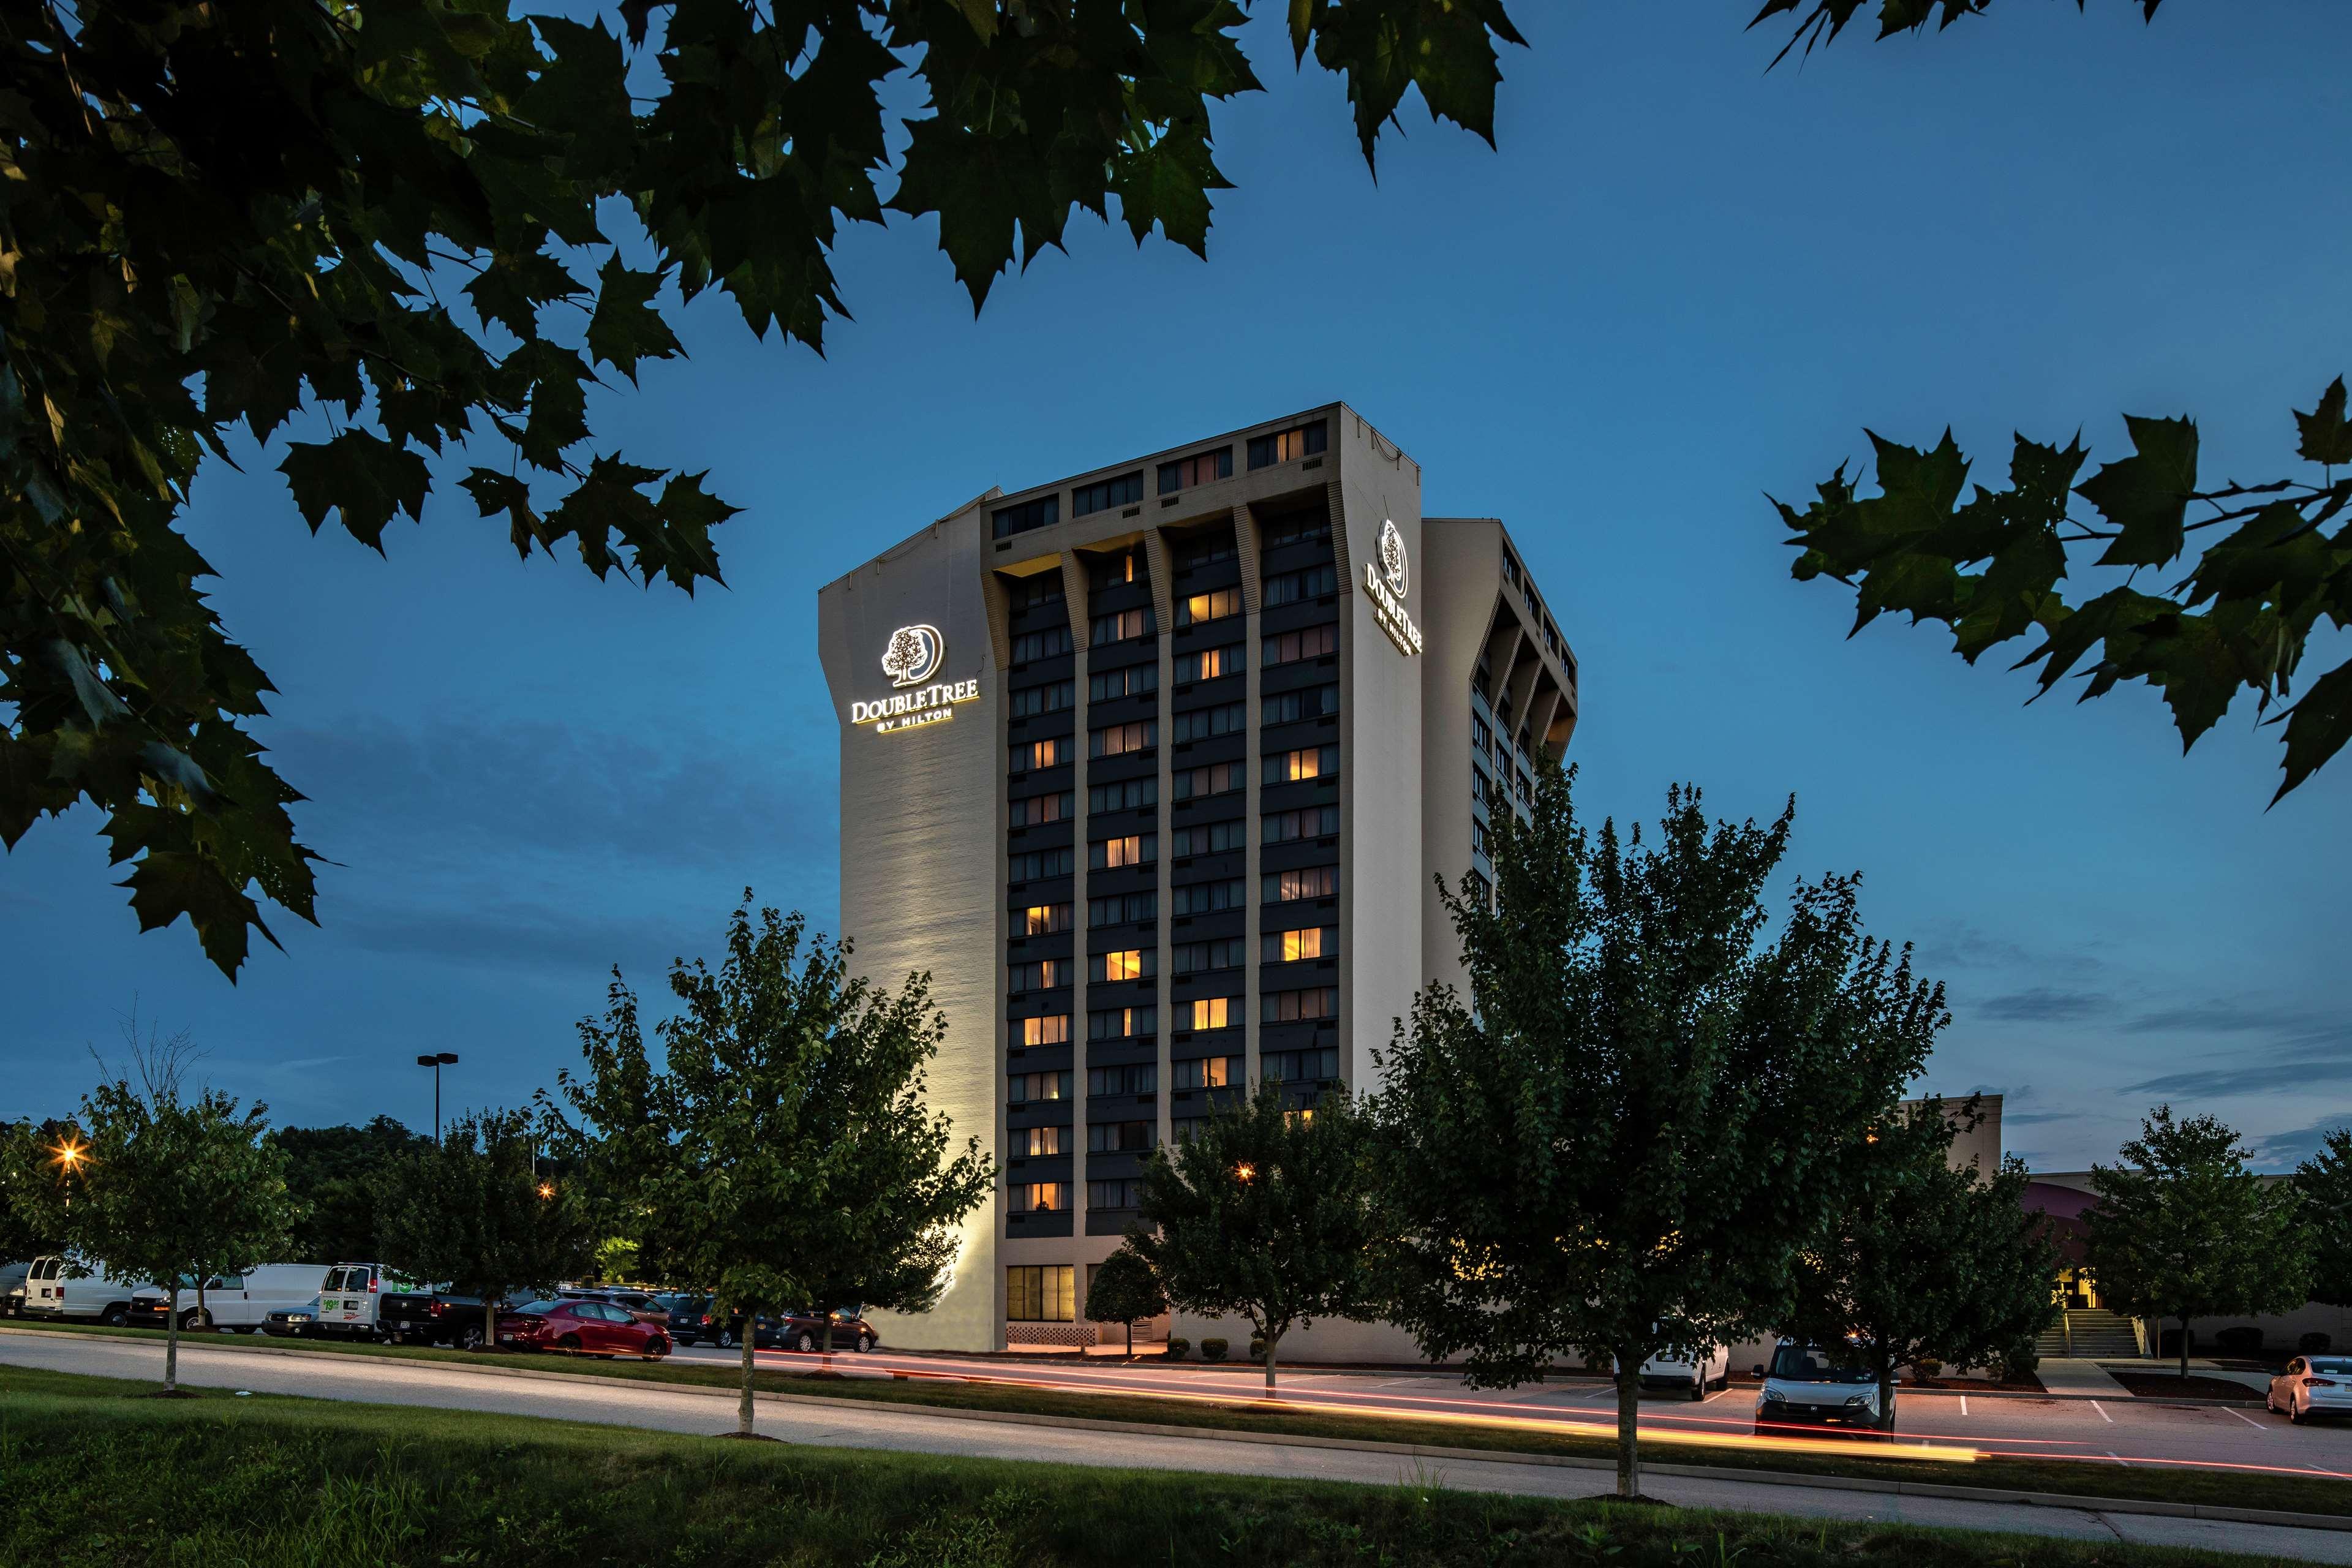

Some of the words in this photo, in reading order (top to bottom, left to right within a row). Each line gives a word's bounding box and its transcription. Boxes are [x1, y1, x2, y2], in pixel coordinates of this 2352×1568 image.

[852, 679, 978, 723] DOUBLETREE
[877, 720, 895, 733] BY
[902, 708, 952, 727] HILTON
